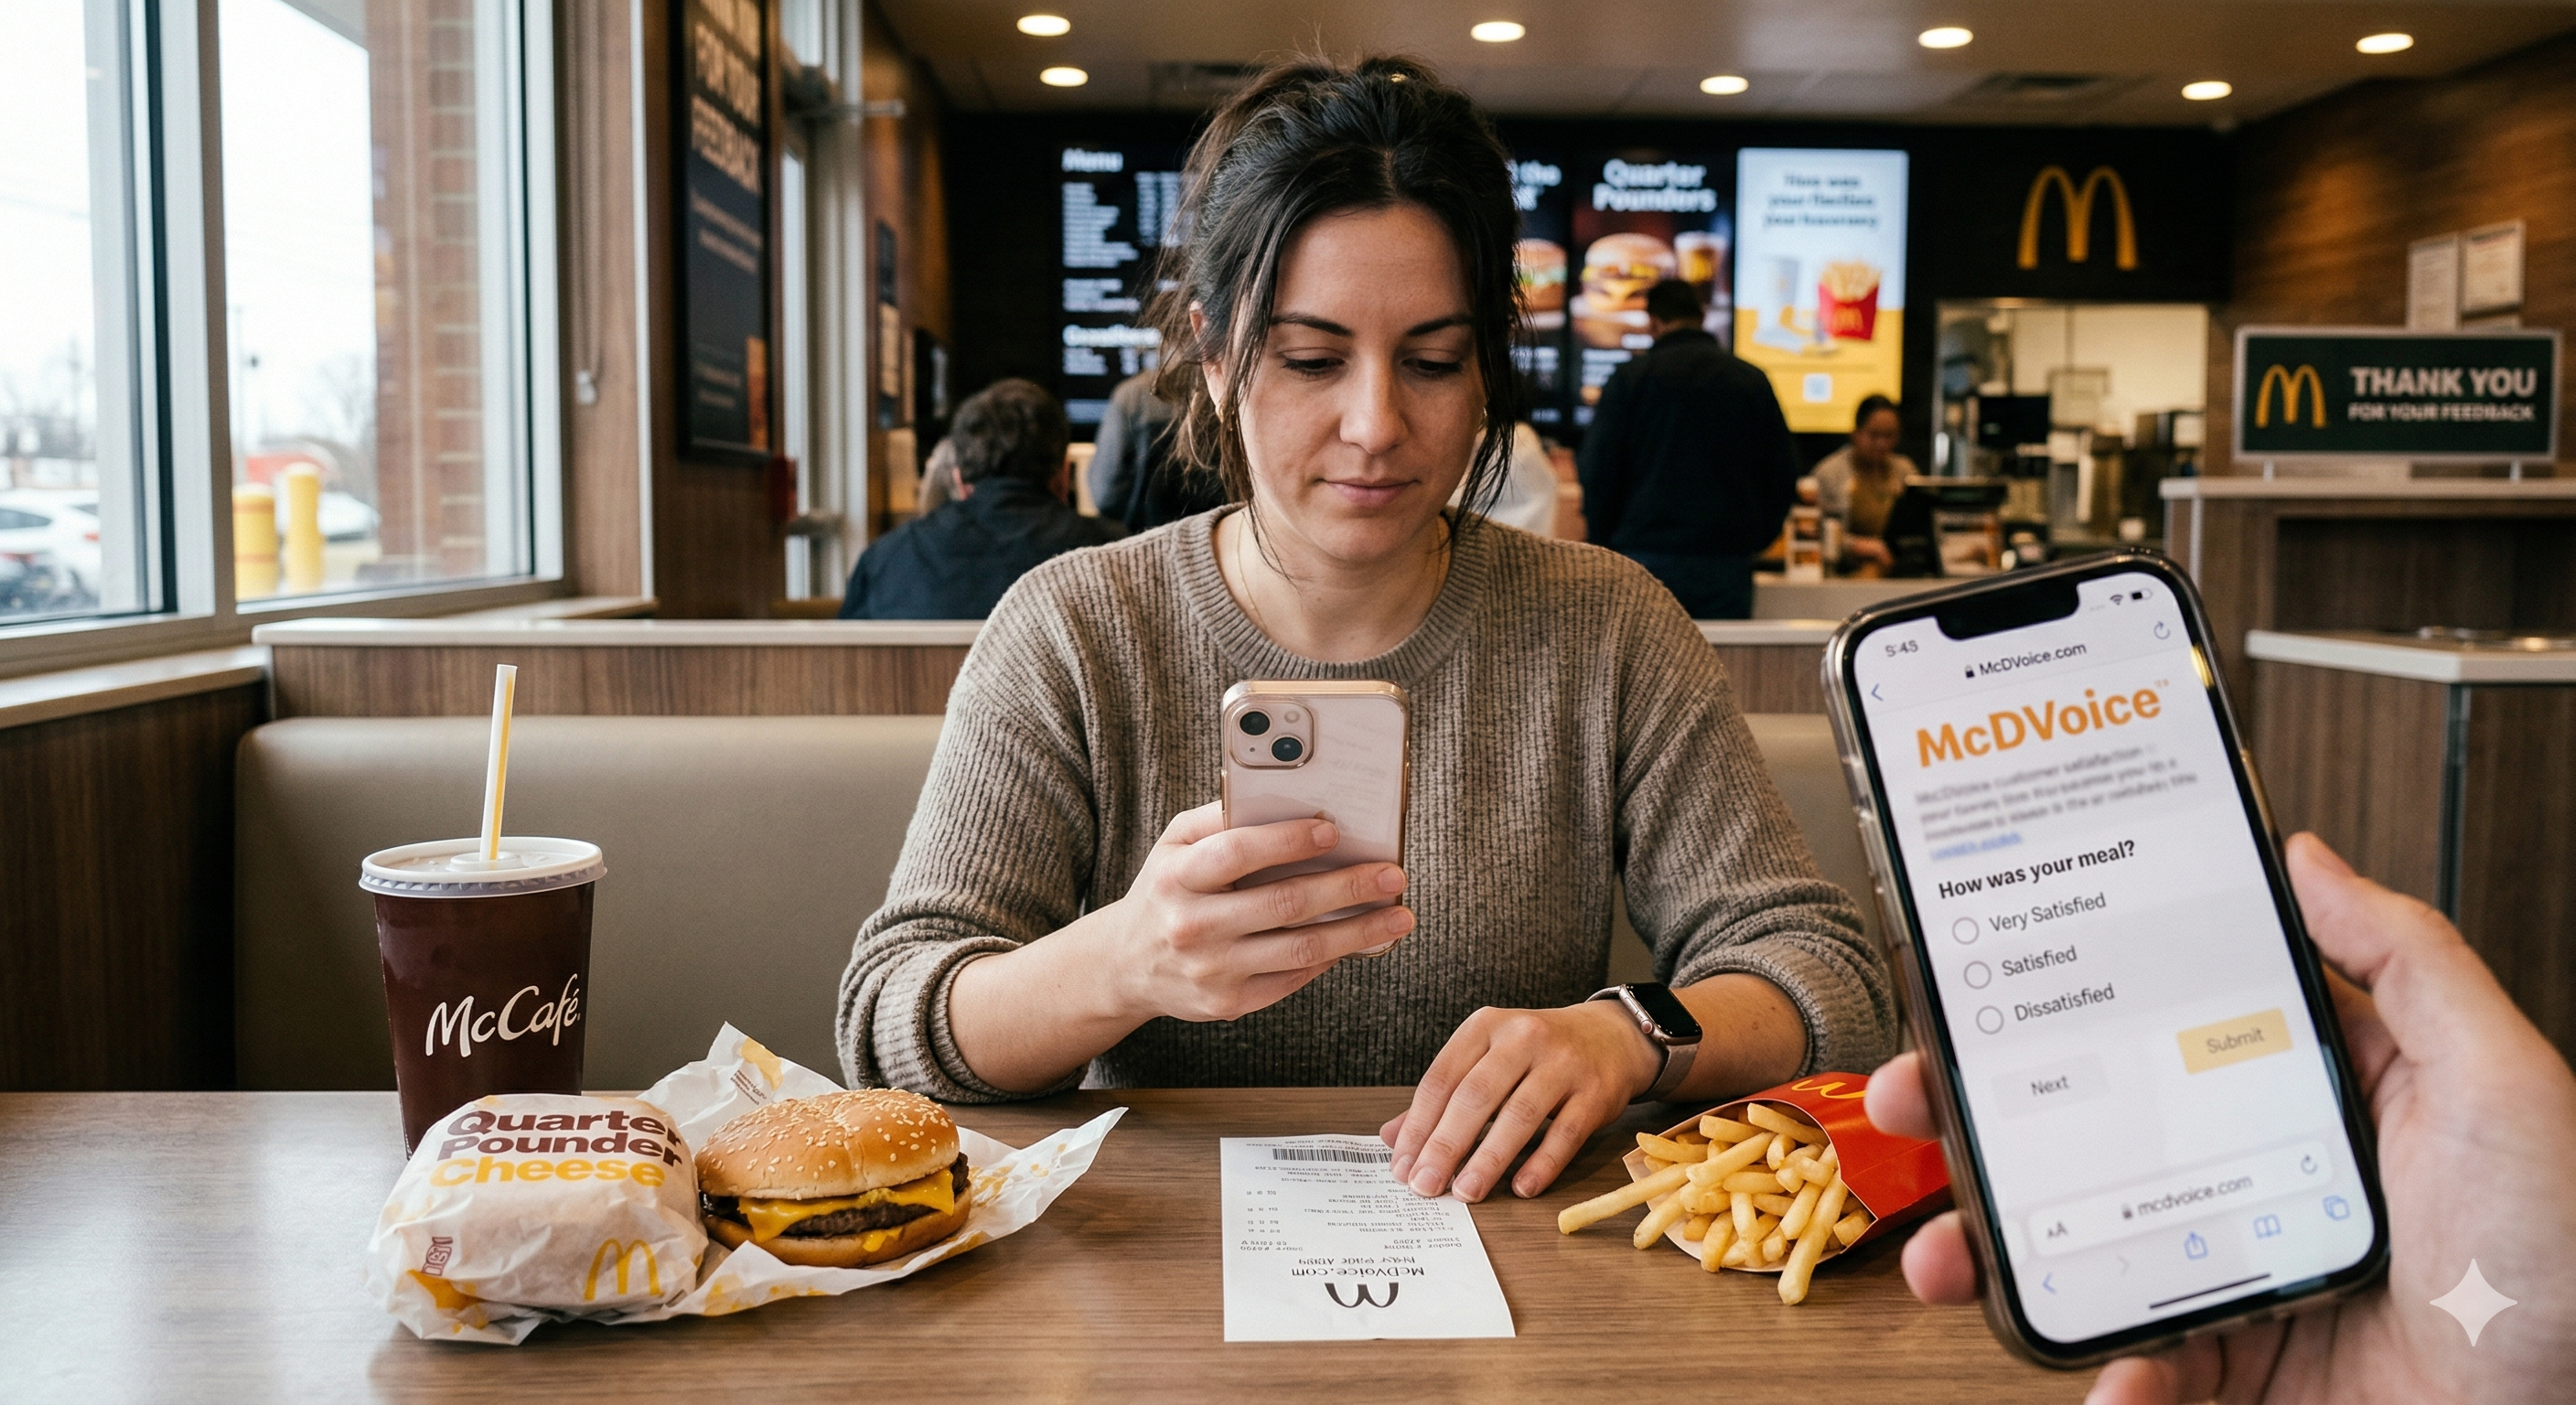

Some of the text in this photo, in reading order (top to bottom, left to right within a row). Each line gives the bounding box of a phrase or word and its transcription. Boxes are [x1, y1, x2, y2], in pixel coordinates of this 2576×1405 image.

[1603, 158, 1707, 188] Quarter
[1593, 183, 1717, 212] Pounders
[2349, 367, 2538, 397] THANK YOU
[2347, 402, 2536, 422] FOR YOUR FEEDBACK
[1979, 642, 2088, 678] McDVoice.com
[1916, 687, 2162, 768] McDVoice
[1938, 839, 2137, 900] How was your meal?
[1989, 892, 2108, 933] Very Satisfied
[2002, 945, 2078, 977] Satisfied
[2014, 983, 2116, 1022] Dissatisfied
[2206, 1027, 2265, 1055] Submit
[2031, 1074, 2071, 1097] Next
[446, 1110, 682, 1148] Quarter
[436, 1132, 682, 1168] Pounder
[429, 1155, 666, 1187] Cheese
[2137, 1175, 2253, 1217] mcdvoice.com
[1291, 1266, 1425, 1278] McDVoice.com
